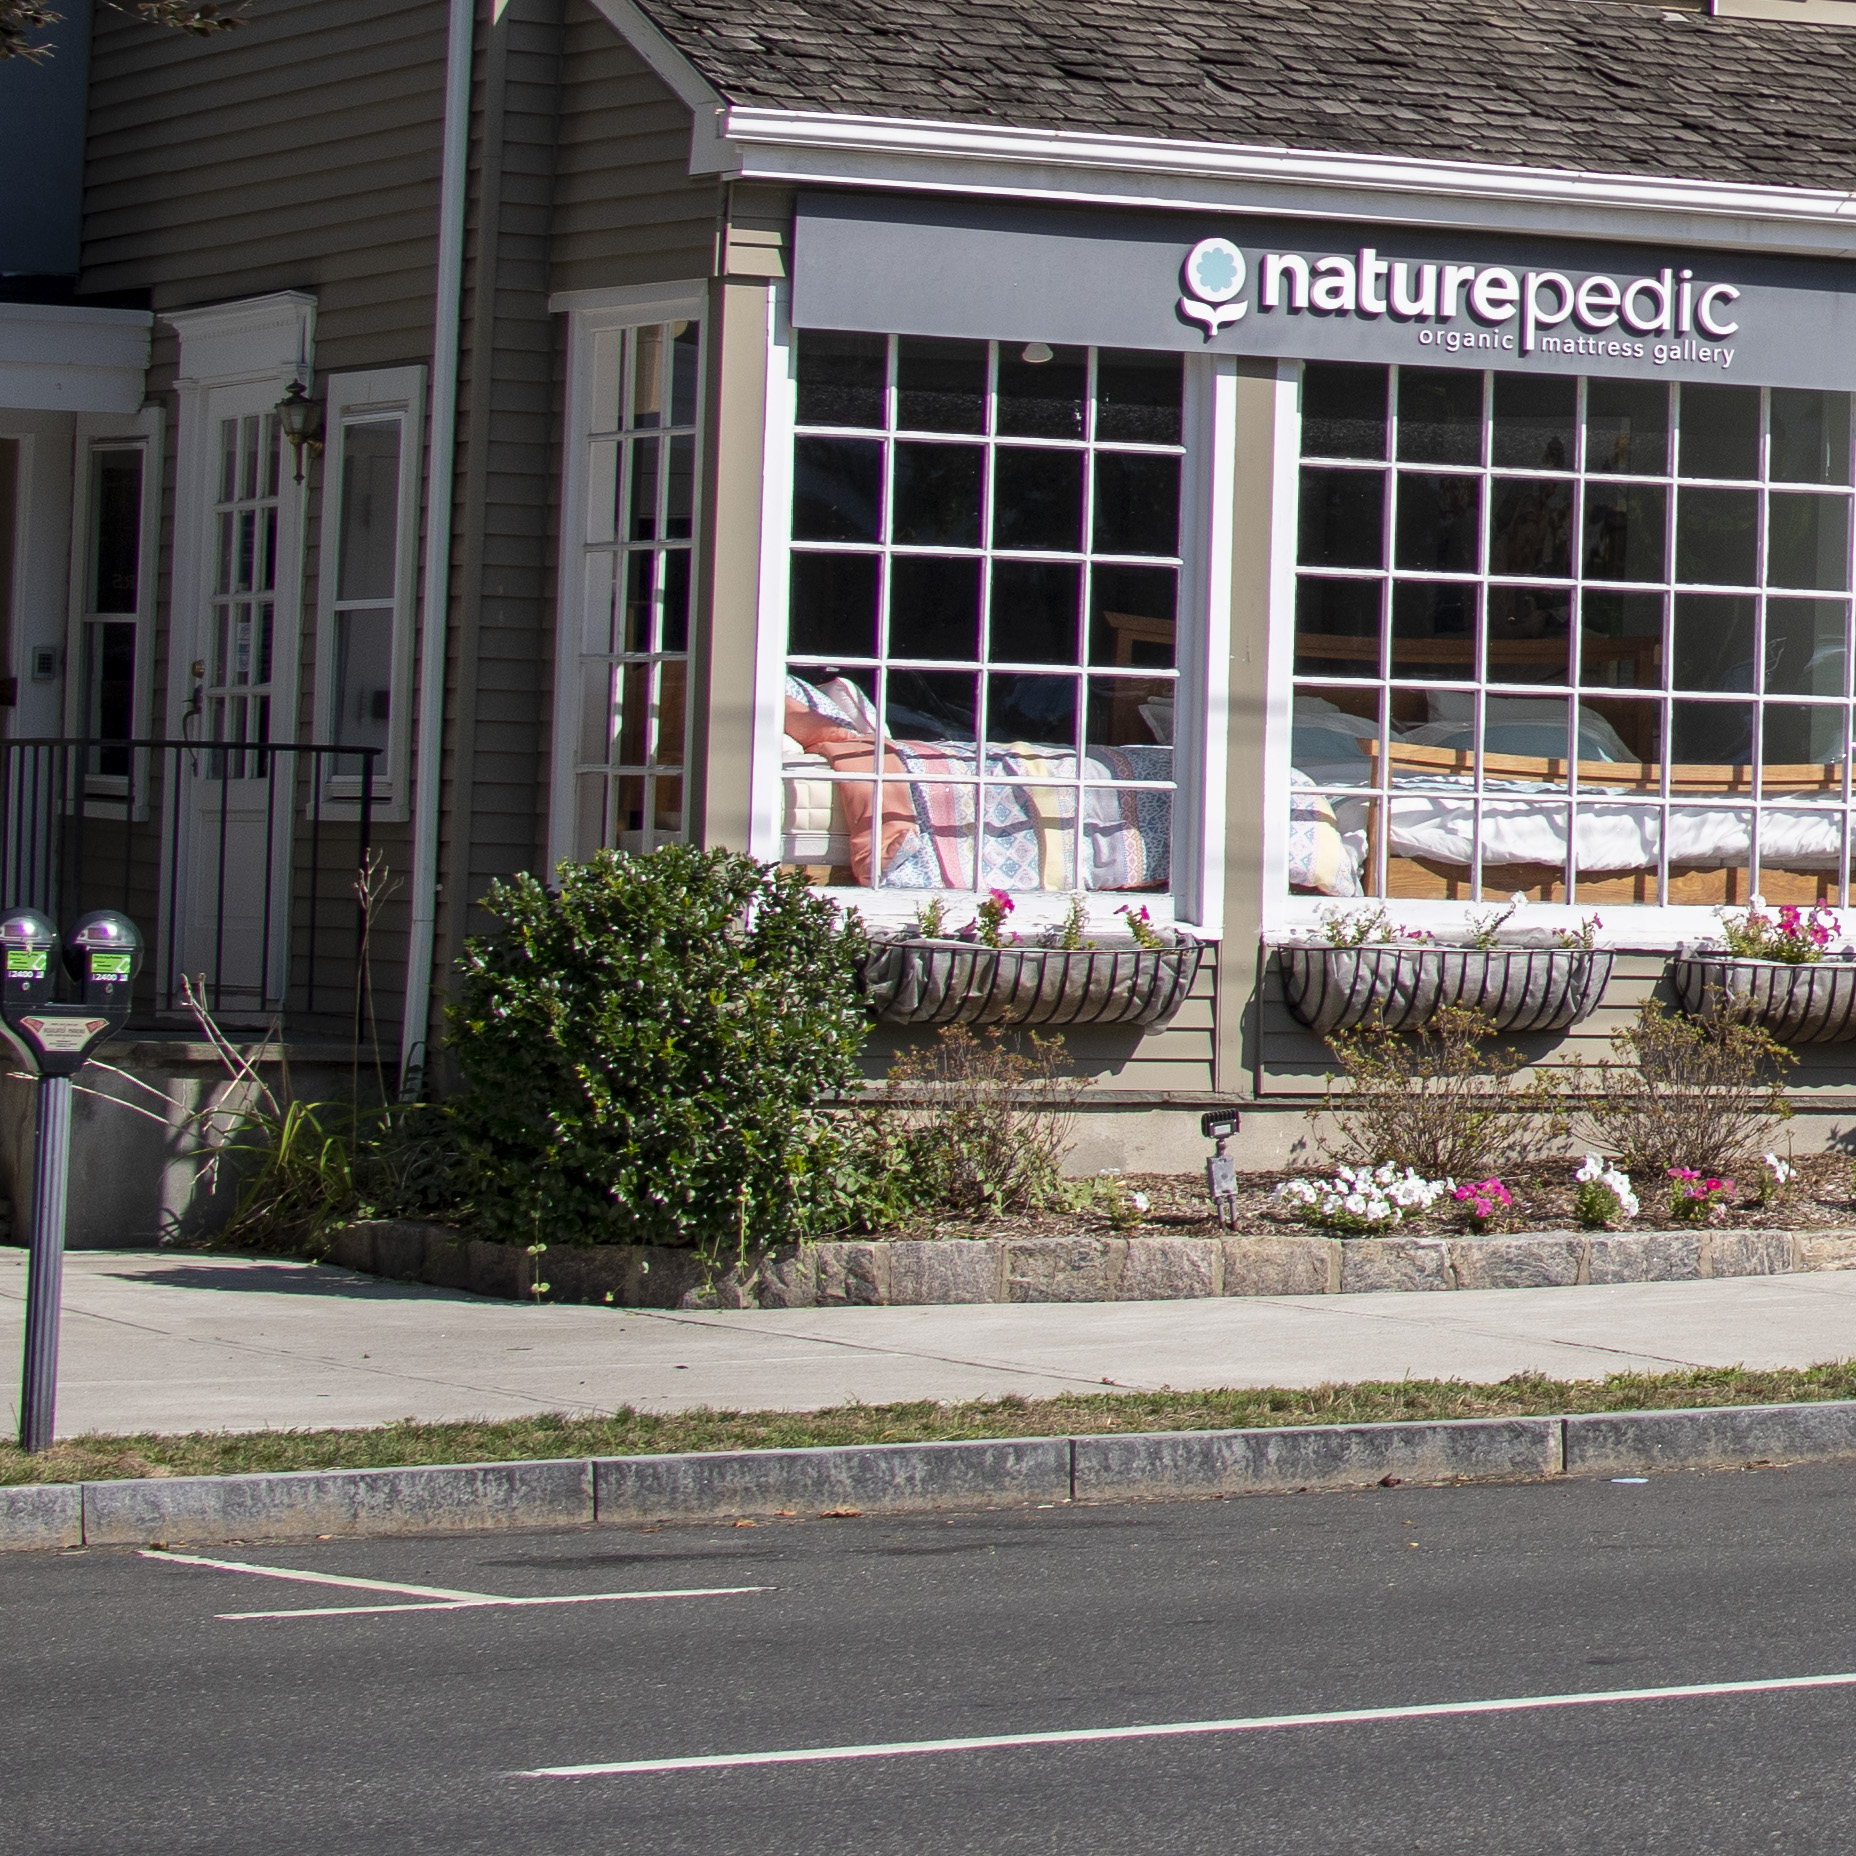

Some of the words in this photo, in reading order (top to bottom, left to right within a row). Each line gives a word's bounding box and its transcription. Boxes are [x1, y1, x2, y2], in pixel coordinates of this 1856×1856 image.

[1262, 247, 1741, 351] naturepedic
[1418, 327, 1515, 352] organic
[1540, 335, 1645, 359] mattress
[1652, 341, 1736, 368] gallery
